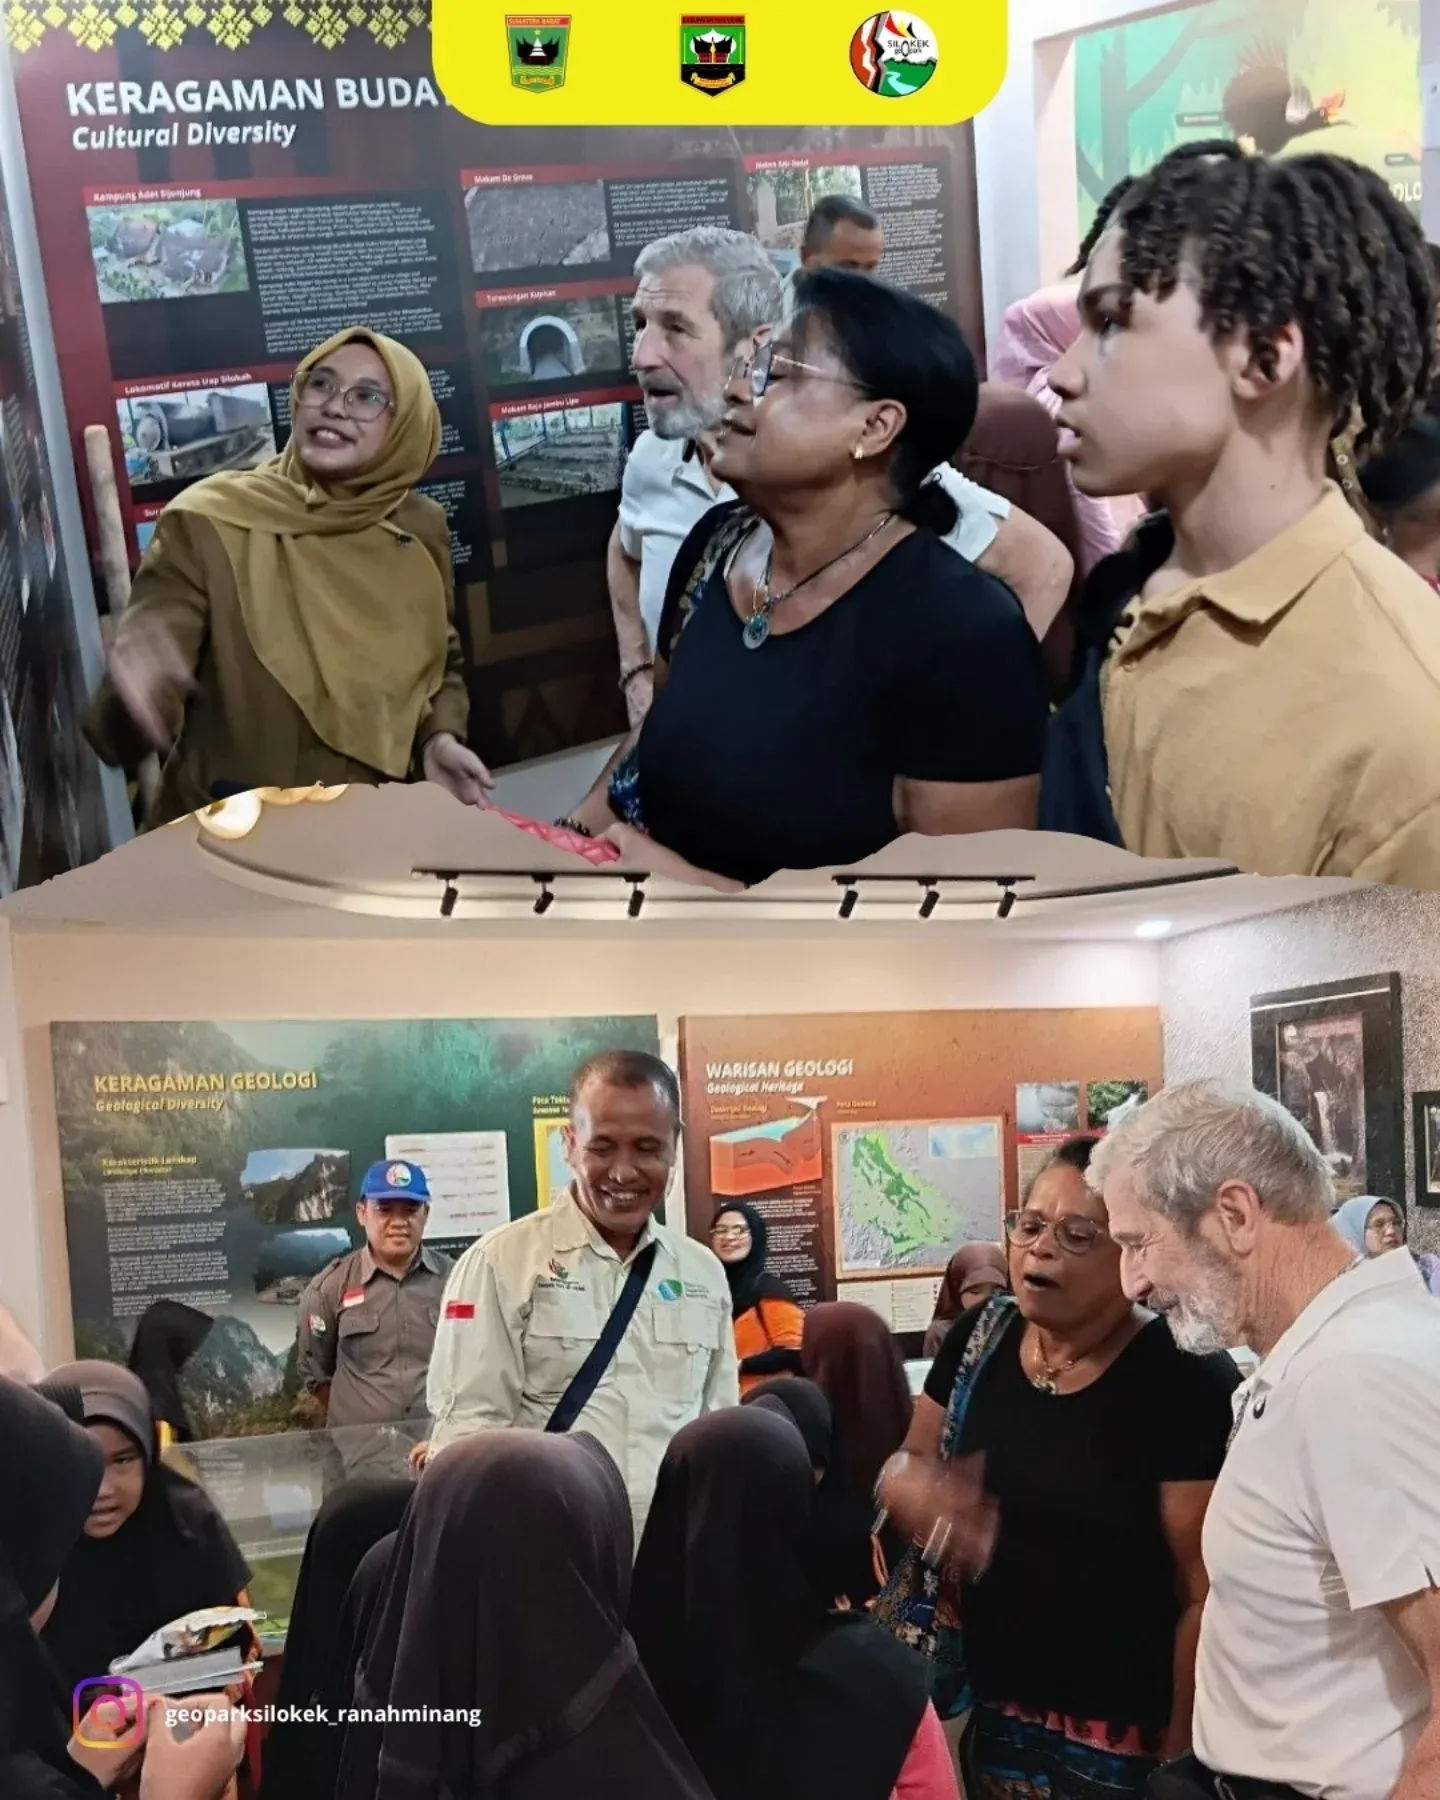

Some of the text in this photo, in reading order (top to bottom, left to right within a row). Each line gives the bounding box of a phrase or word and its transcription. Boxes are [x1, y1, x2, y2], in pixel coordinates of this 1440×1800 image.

[66, 77, 452, 117] KERAGAMAN BUDA
[72, 120, 297, 151] Cultural Diversity
[706, 1058, 854, 1079] WARISAN GEOLOGI
[93, 1071, 318, 1093] KERAGAMAN GEOLOGI
[707, 1079, 805, 1096] Geological Heritage
[95, 1095, 225, 1114] Geological Diversity
